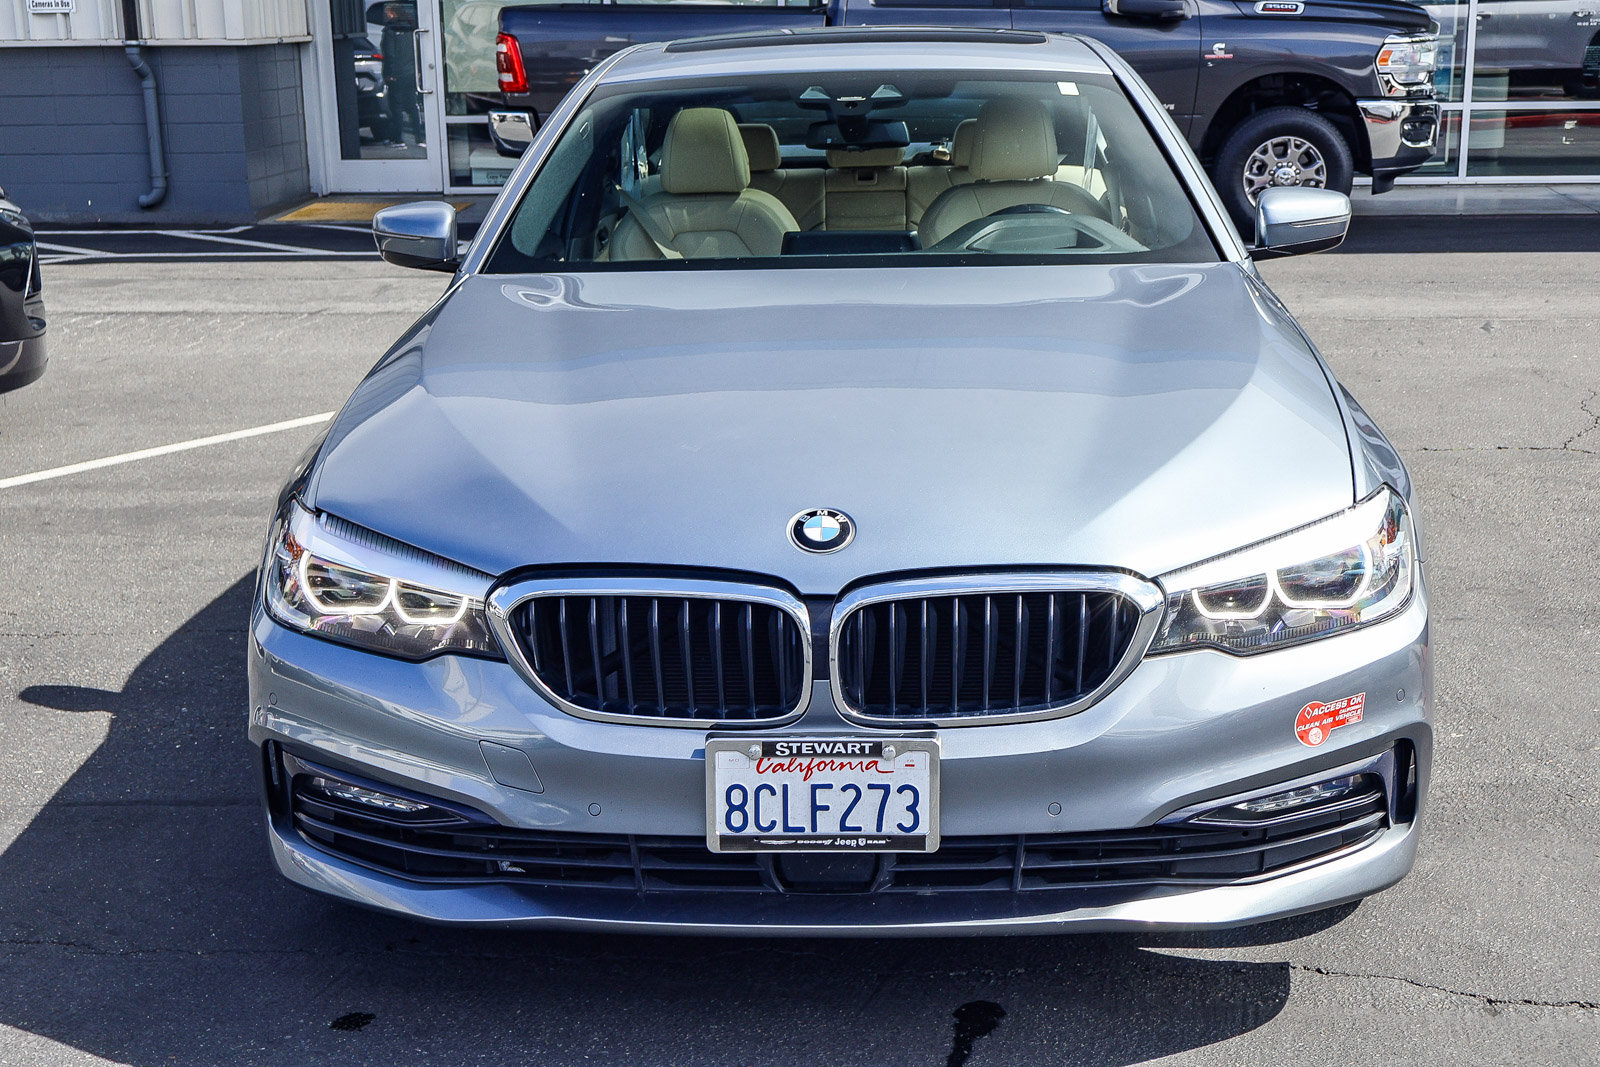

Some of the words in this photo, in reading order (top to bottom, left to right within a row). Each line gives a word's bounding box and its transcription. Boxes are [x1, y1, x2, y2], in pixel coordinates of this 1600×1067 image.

[31, 0, 53, 8] Cameras
[799, 509, 847, 523] BMW
[1312, 700, 1348, 717] ACCESS
[1349, 695, 1363, 706] OK
[1297, 721, 1321, 732] CLEAN
[1322, 717, 1334, 726] AIR
[1335, 708, 1362, 721] VEHICLE
[775, 742, 874, 757] STEWART
[756, 757, 895, 782] California
[724, 783, 920, 833] 8CLF273
[834, 837, 857, 847] Jeep
